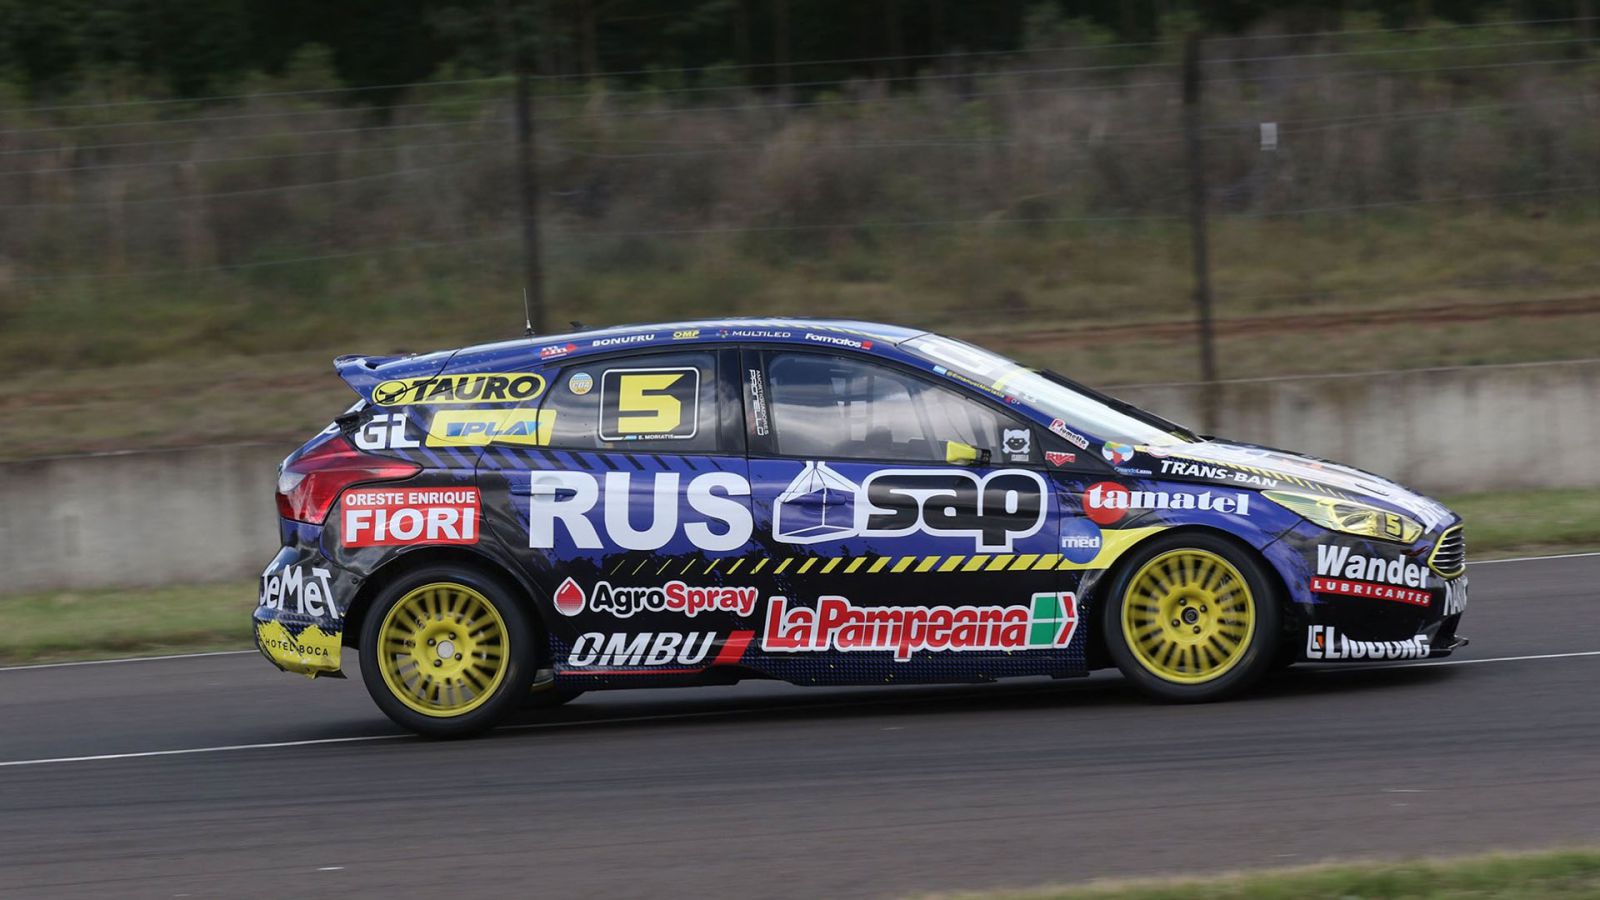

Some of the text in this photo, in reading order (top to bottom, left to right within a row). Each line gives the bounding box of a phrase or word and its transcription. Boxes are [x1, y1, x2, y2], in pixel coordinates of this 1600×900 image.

[592, 334, 655, 347] BONUFRU
[673, 330, 700, 338] OMP
[732, 330, 791, 338] MULTILED
[412, 376, 541, 401] TAURO
[618, 374, 685, 433] 5
[459, 421, 534, 437] PLA
[1160, 459, 1278, 488] TRANS-BAN
[346, 491, 476, 506] ORESTE ENRIQUE
[529, 470, 753, 551] RUS
[864, 471, 1044, 549] sap
[1087, 484, 1250, 516] tamatel
[346, 507, 475, 543] FIORI
[1385, 513, 1403, 537] 5
[1061, 536, 1100, 548] med
[1317, 544, 1430, 589] Wander
[591, 581, 757, 617] AgroSpray
[1313, 580, 1430, 604] LUBRICANTES
[265, 639, 329, 656] HOTEL BOCA
[568, 631, 717, 667] OMBU
